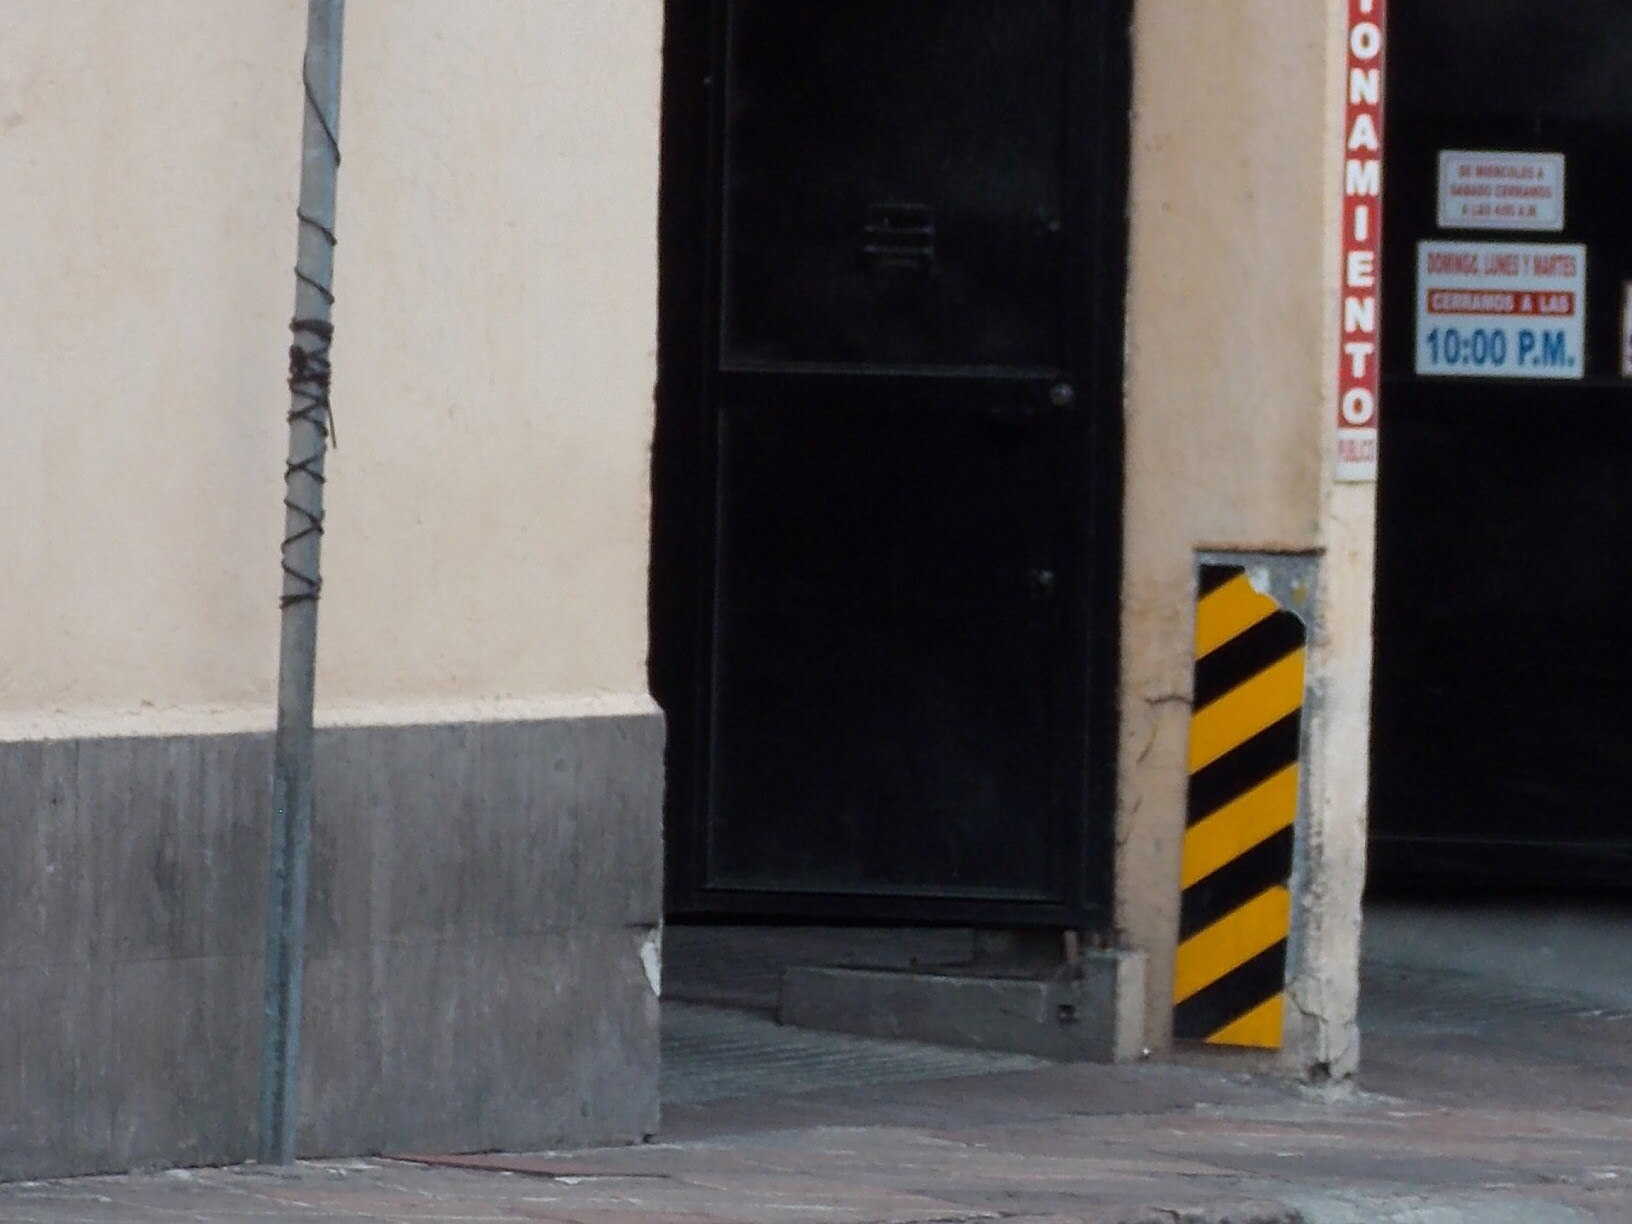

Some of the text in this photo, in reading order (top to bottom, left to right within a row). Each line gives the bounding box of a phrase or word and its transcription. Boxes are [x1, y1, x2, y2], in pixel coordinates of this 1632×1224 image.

[1522, 255, 1531, 274] Y
[1520, 293, 1533, 314] A
[1538, 293, 1571, 315] LAS
[1427, 328, 1576, 367] 10:00 P.M.
